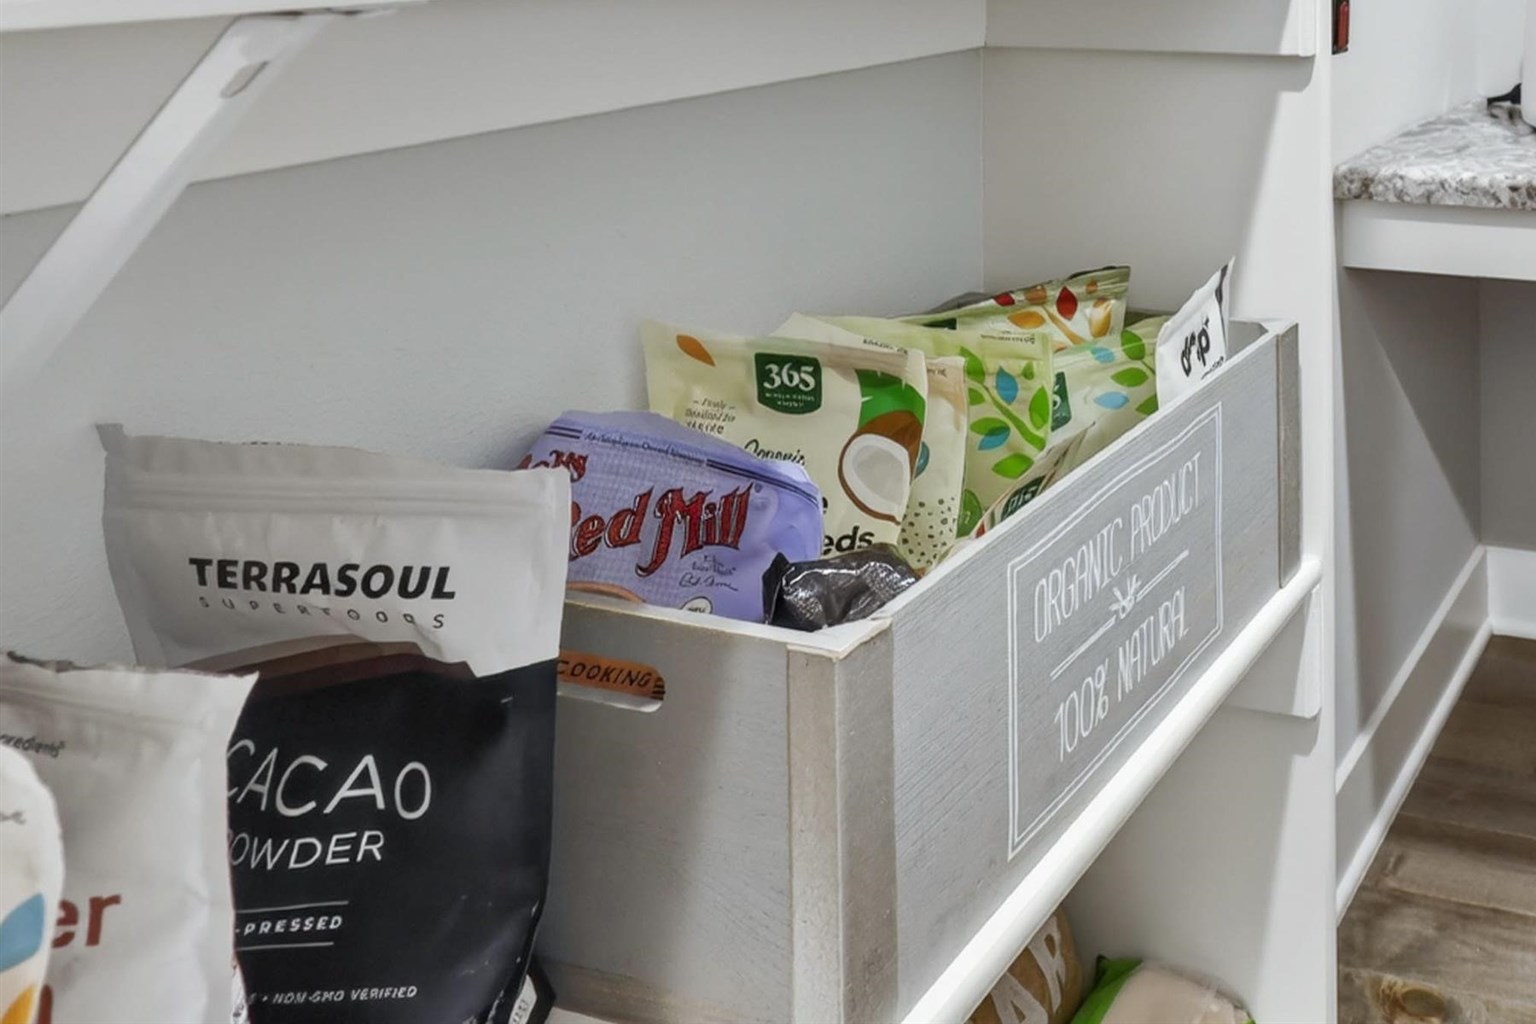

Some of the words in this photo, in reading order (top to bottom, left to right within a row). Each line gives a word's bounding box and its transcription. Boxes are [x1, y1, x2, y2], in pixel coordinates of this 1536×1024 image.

[763, 362, 816, 392] 365
[635, 481, 755, 578] Mill
[1034, 516, 1125, 644] ORGANIC
[1130, 451, 1202, 564] PRODUCT
[189, 557, 456, 600] TERRASOUL
[199, 596, 446, 630] SUPERFOODS
[557, 660, 652, 688] COOKING
[1053, 660, 1111, 763] 100%
[1117, 586, 1191, 704] NATURAL
[226, 738, 431, 820] CACAO
[228, 830, 386, 872] OWDER
[236, 915, 344, 937] -PRESSED
[272, 989, 345, 1005] NON-GMO
[351, 986, 418, 1002] VERIFIED
